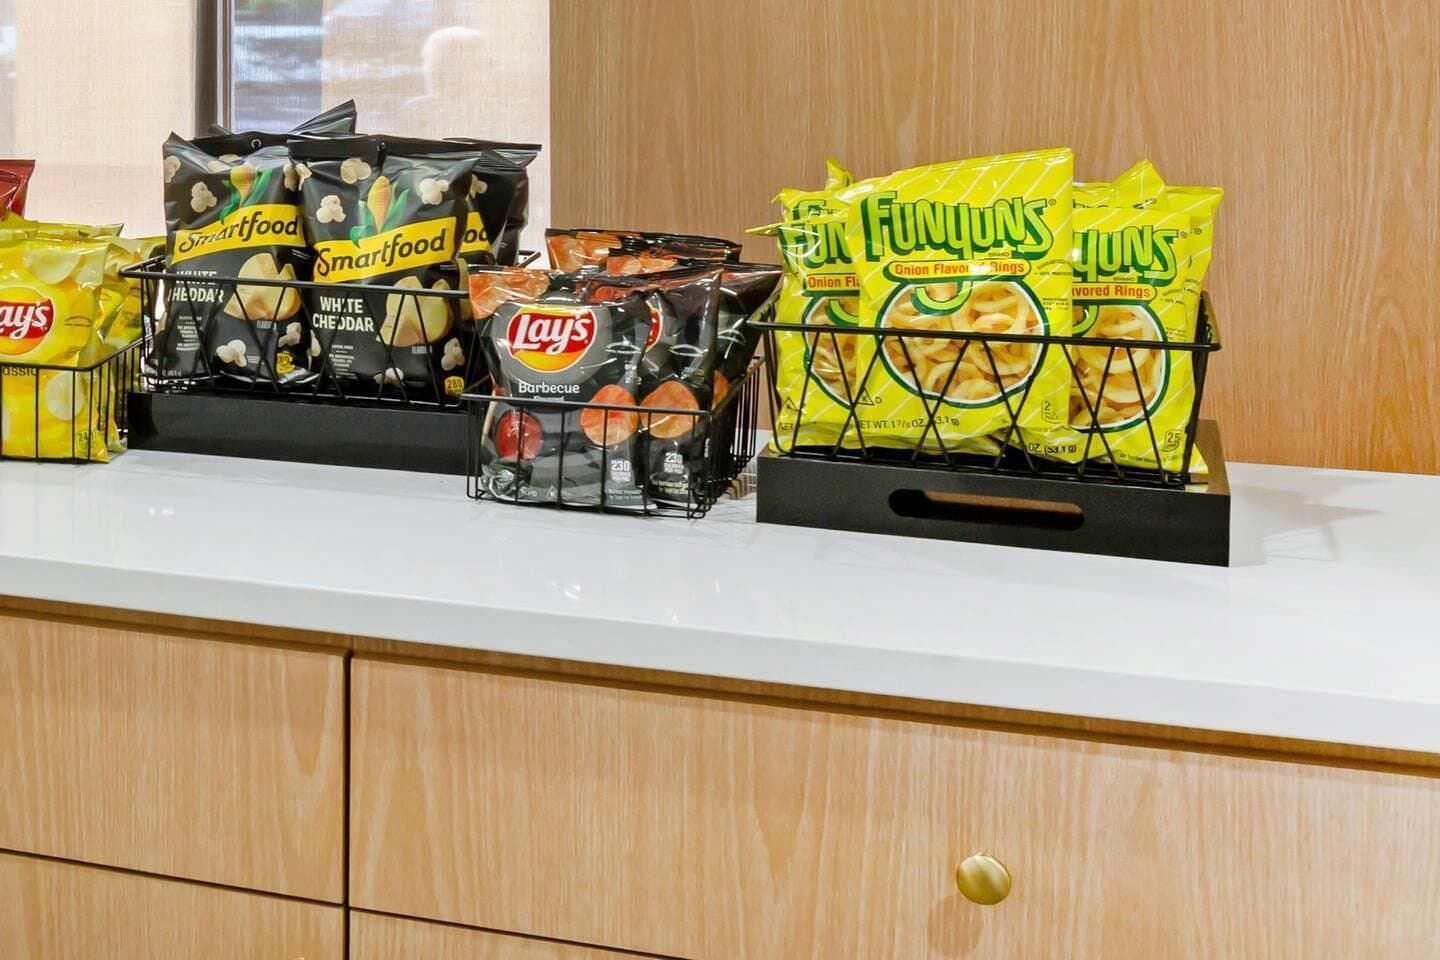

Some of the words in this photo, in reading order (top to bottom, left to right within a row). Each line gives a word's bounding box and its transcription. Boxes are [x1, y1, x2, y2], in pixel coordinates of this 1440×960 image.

[178, 210, 300, 254] Smartfood
[316, 228, 449, 277] Smartfood
[894, 264, 929, 277] Onion
[933, 262, 985, 275] Flavord
[990, 260, 1026, 275] Rings
[807, 276, 841, 289] Onion
[1114, 285, 1151, 299] Rings
[511, 310, 592, 356] Lay's
[518, 381, 581, 394] Barbecue
[664, 452, 684, 465] 230
[610, 460, 631, 472] 230
